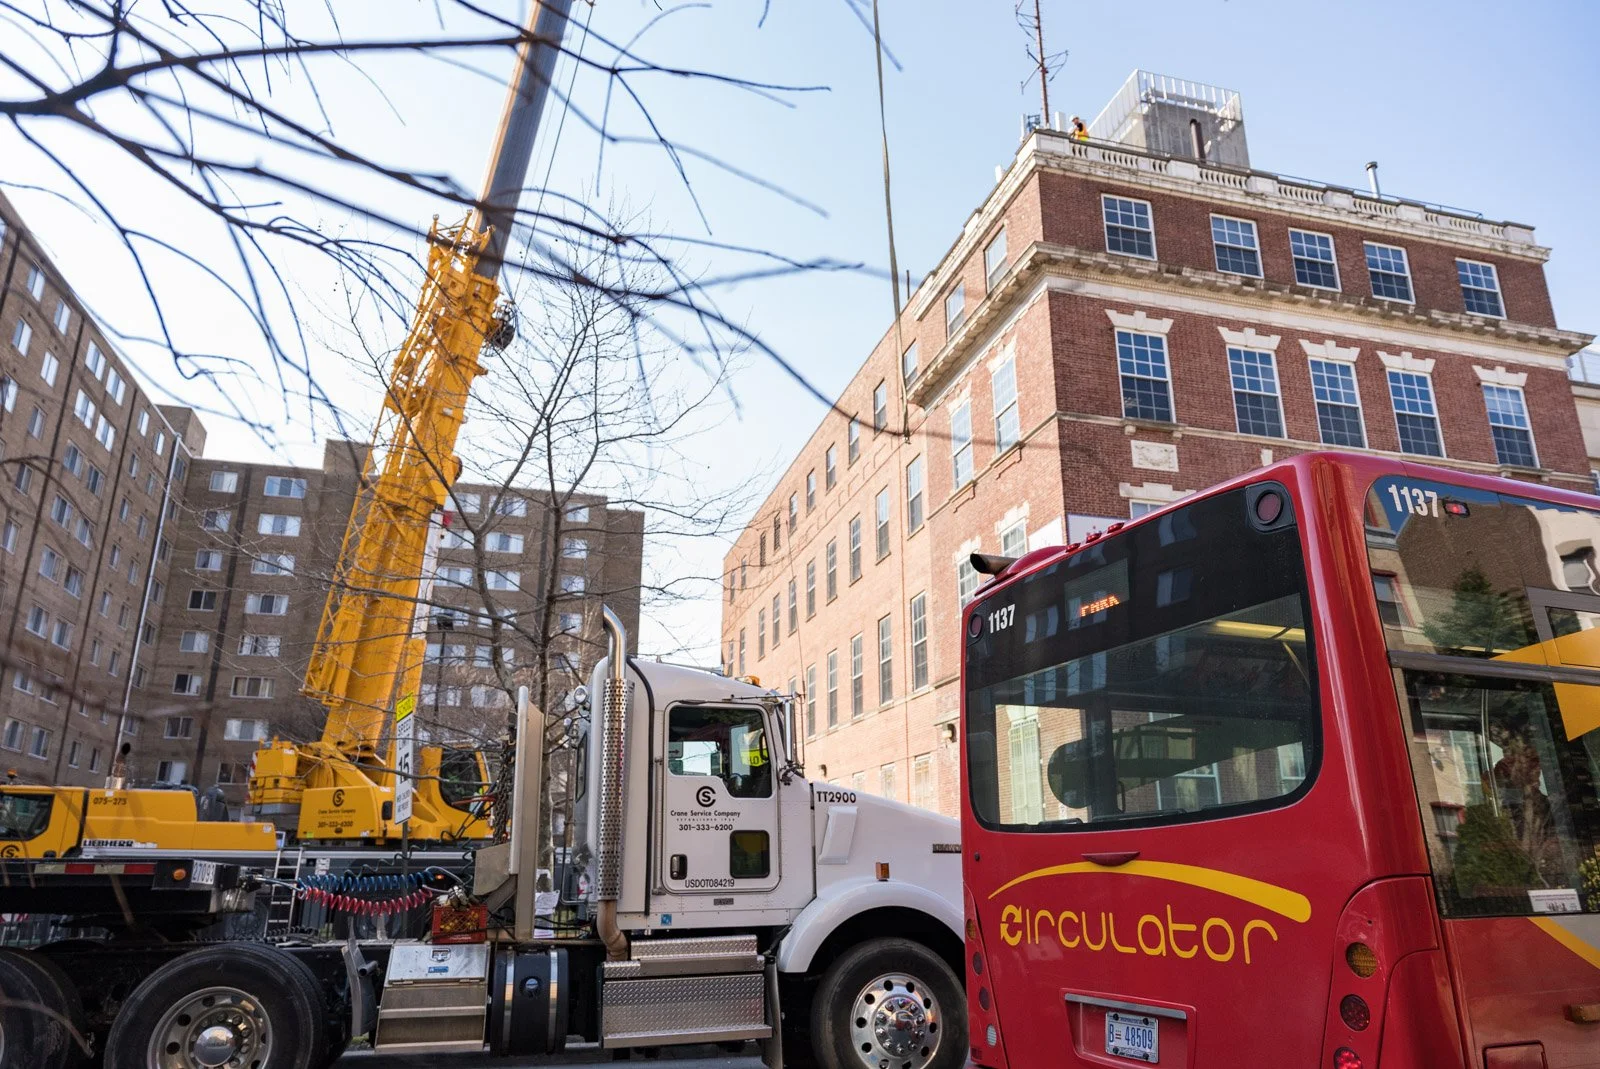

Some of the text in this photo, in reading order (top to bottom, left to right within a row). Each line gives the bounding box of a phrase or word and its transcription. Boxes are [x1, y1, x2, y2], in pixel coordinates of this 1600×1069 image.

[1387, 484, 1439, 518] 1137
[988, 603, 1016, 634] 1137
[816, 791, 857, 803] TT2900
[690, 809, 712, 817] Service
[713, 809, 741, 818] Company
[679, 823, 733, 831] 301-333-6200
[684, 878, 735, 889] USDOT084219
[1125, 1026, 1153, 1050] 48509
